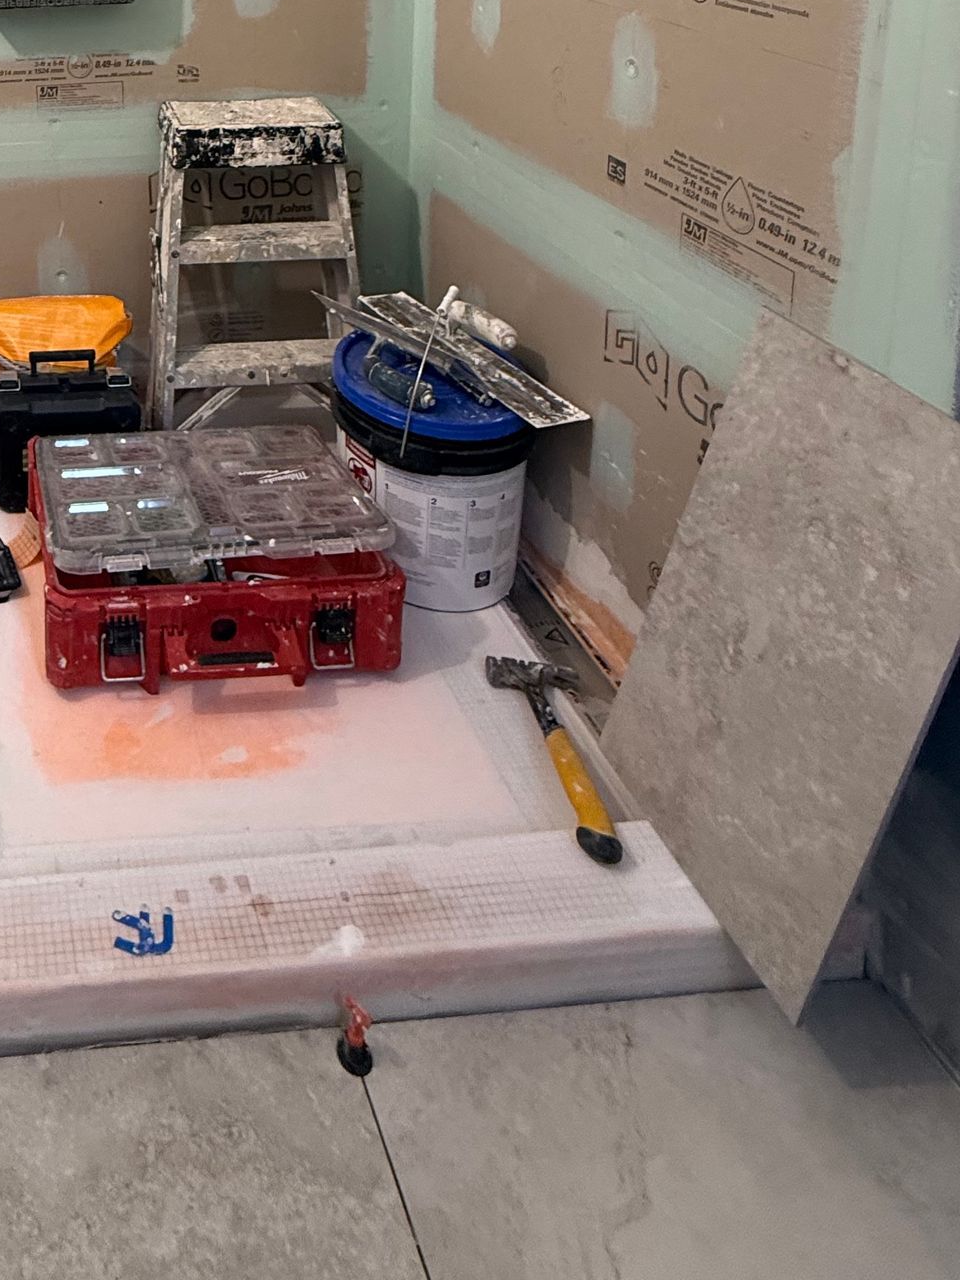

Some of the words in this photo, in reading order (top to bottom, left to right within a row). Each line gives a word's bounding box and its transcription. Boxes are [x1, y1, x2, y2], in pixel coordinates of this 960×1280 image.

[608, 159, 626, 182] ES
[682, 176, 696, 189] 3-ft
[704, 187, 719, 200] 5-ft
[682, 186, 700, 202] 1524
[758, 217, 797, 246] 0.49-in
[802, 239, 828, 260] 12.4
[828, 254, 841, 267] m
